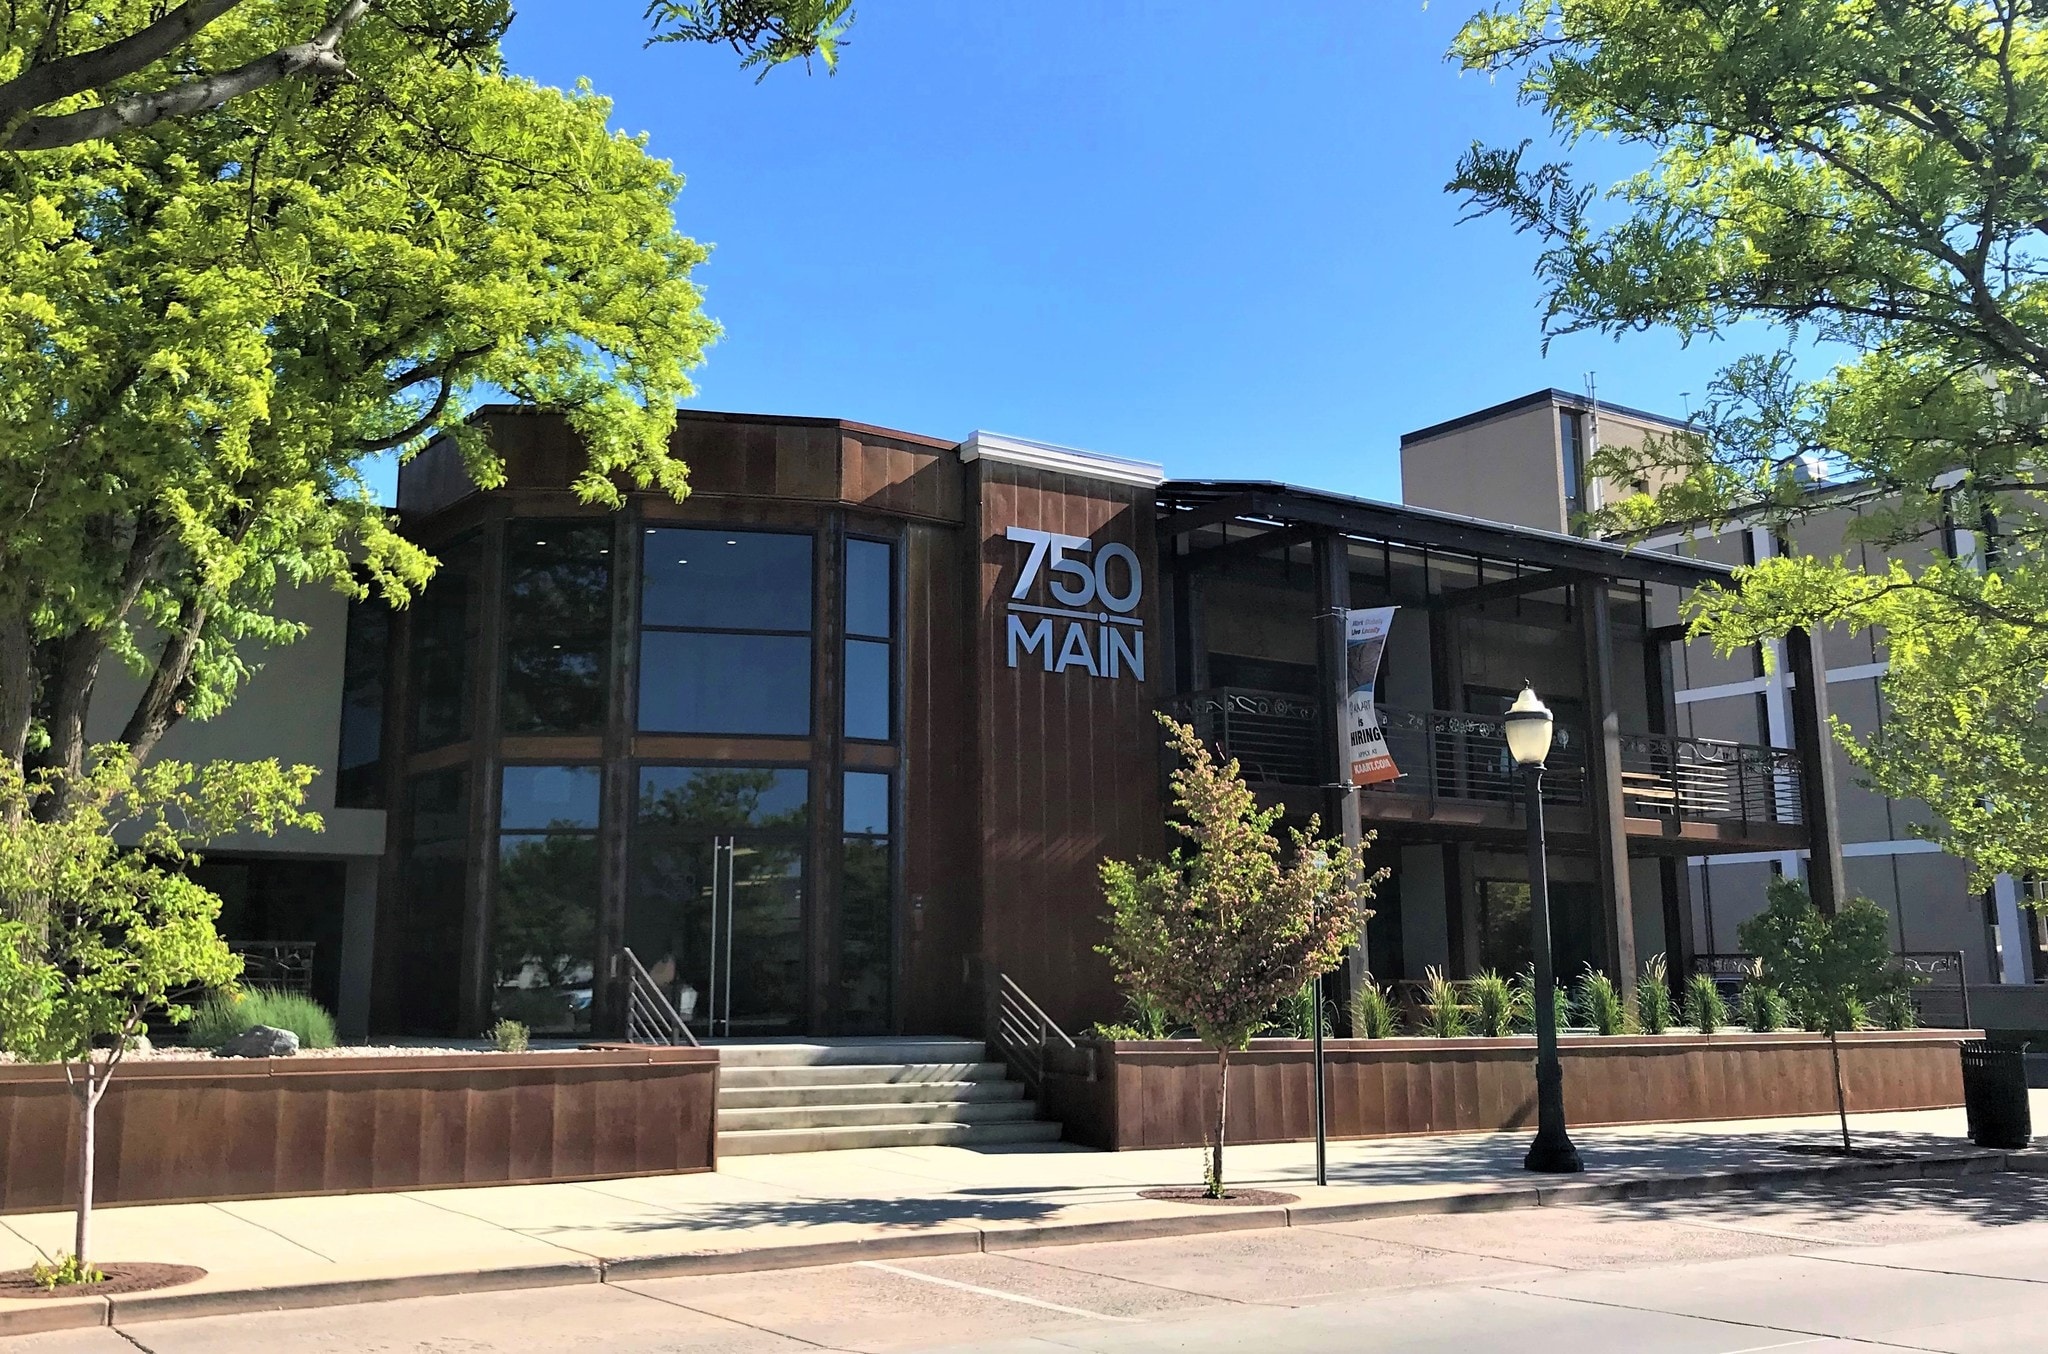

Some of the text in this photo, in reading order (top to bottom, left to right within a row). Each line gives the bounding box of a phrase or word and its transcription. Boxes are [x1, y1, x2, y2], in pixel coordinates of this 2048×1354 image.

[1006, 526, 1142, 613] 750
[1350, 727, 1382, 747] HIRING
[1353, 759, 1391, 774] KAART.COM
